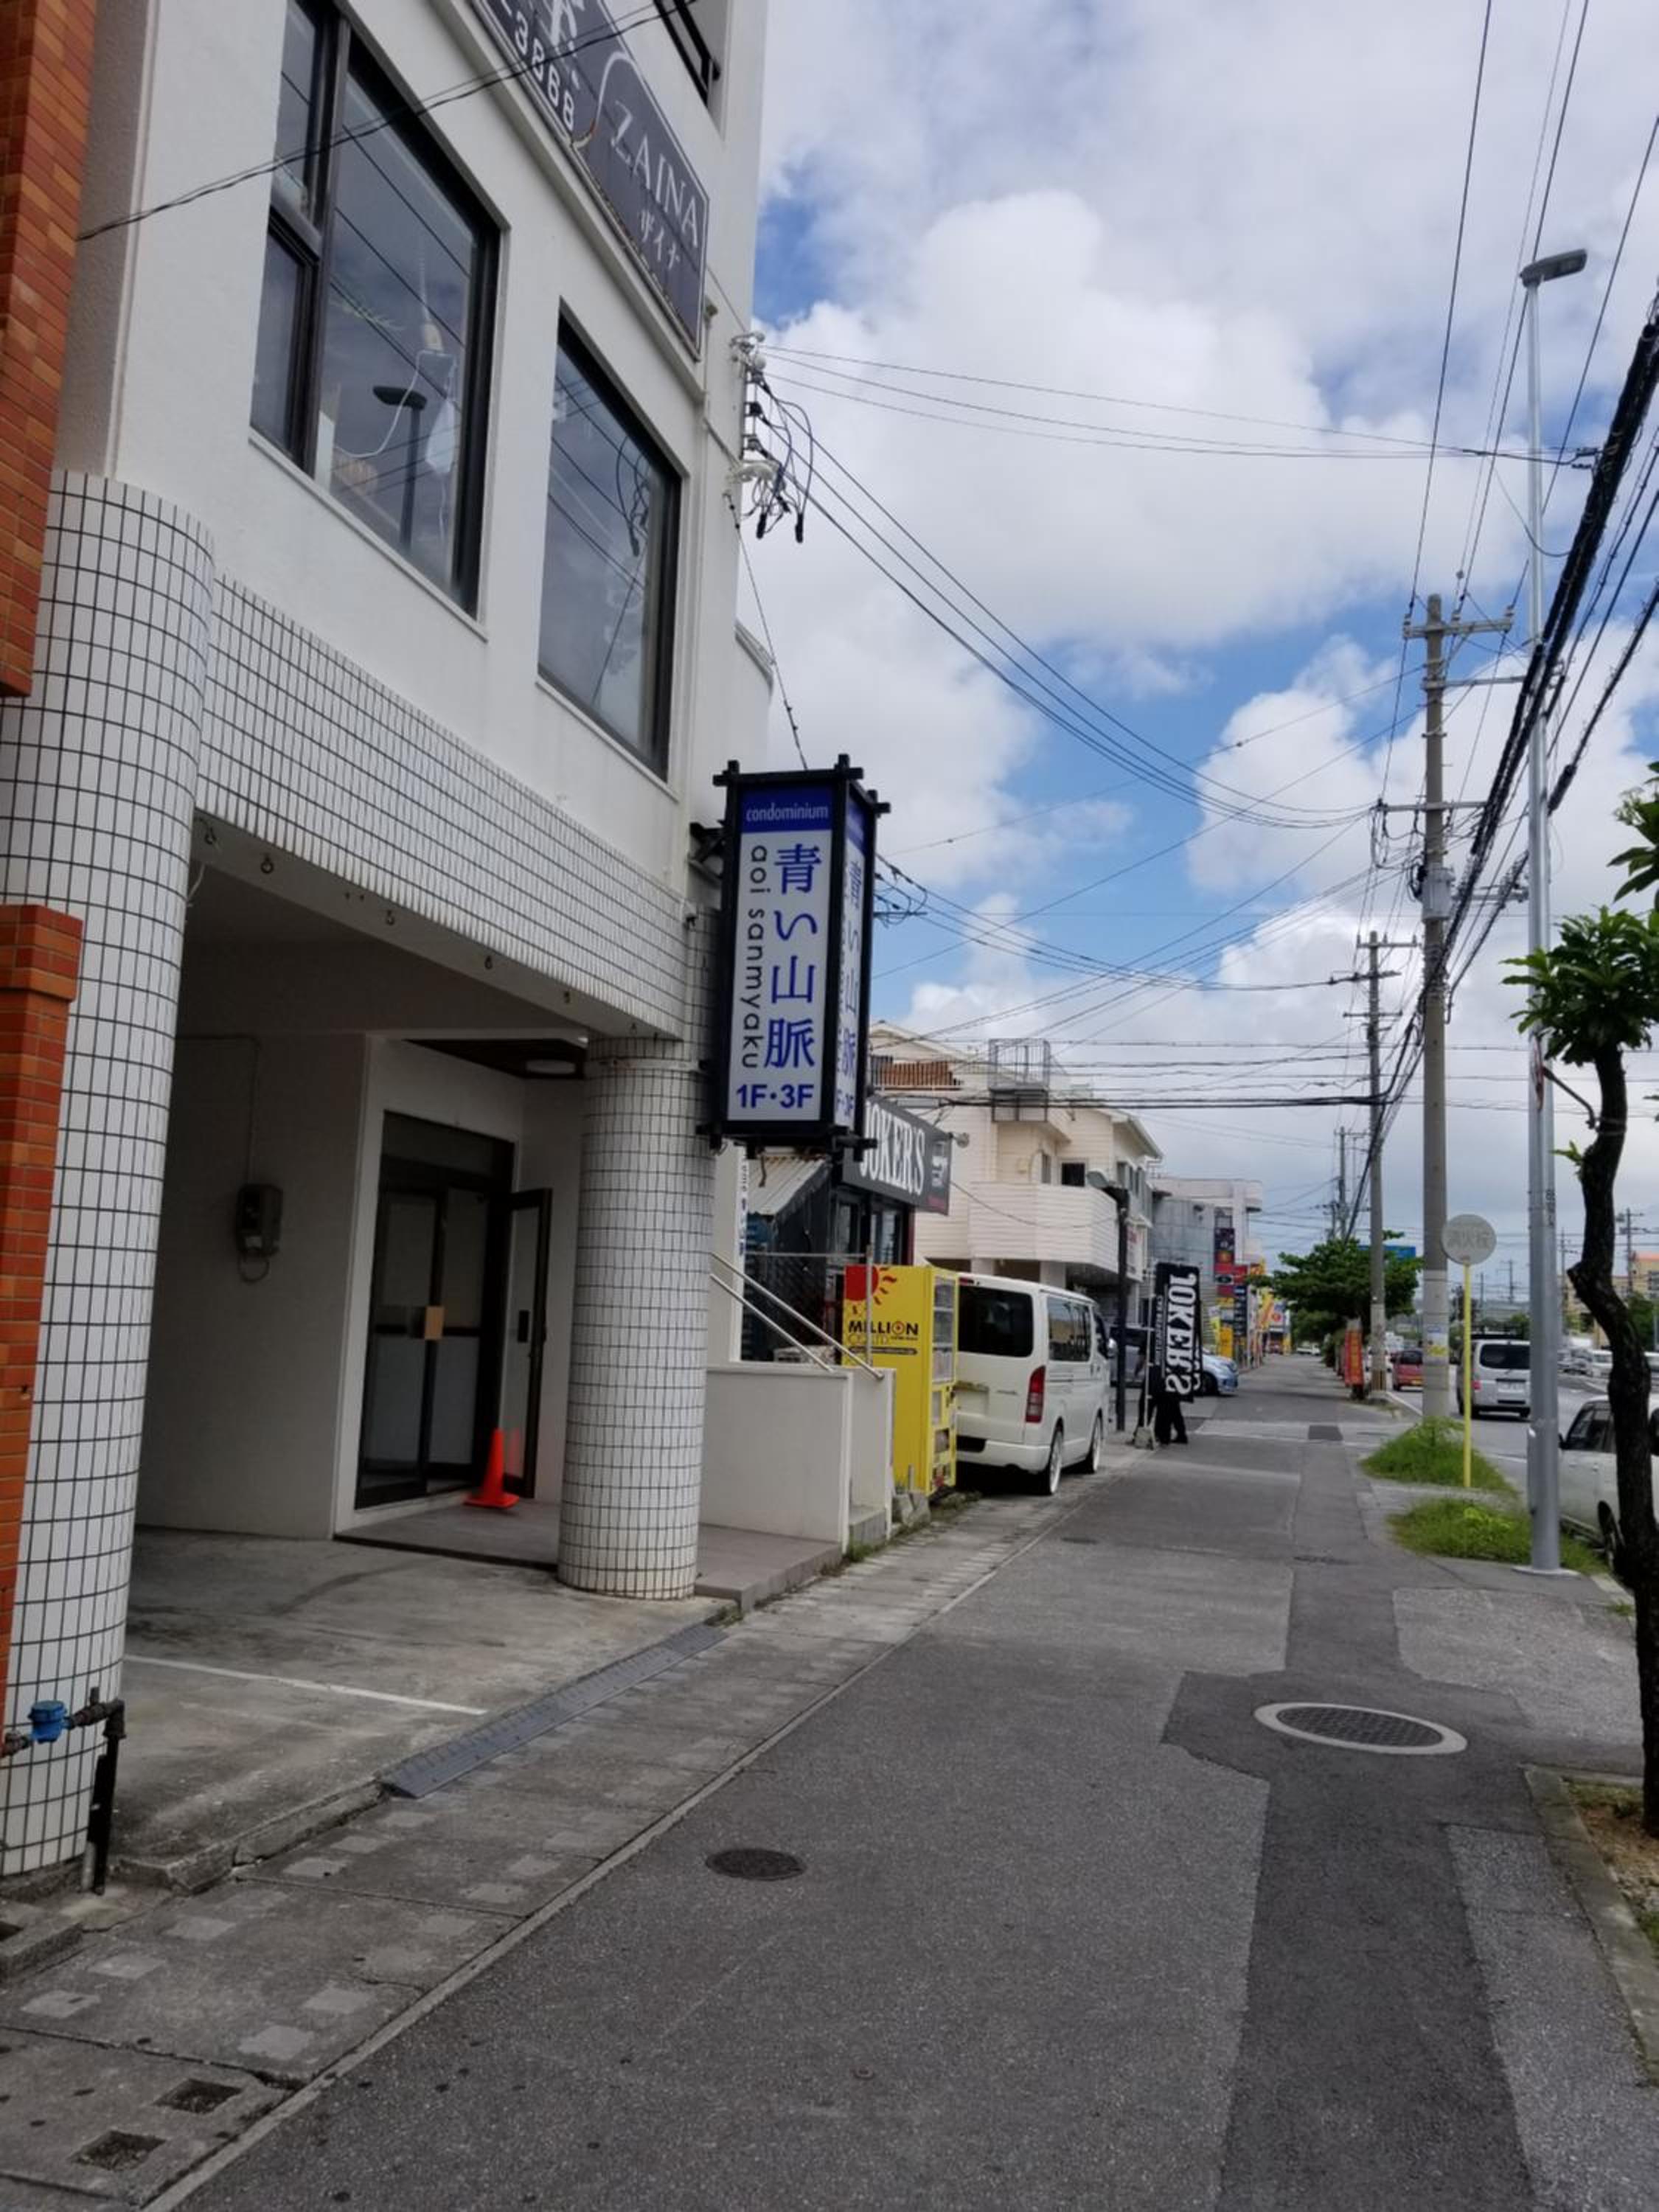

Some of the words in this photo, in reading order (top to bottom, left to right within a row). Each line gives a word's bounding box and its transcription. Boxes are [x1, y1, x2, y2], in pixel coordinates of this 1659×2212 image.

[611, 99, 698, 248] ZAINA
[745, 802, 829, 821] condominium
[750, 845, 771, 894] aoi
[740, 908, 765, 1068] sanmyaku
[763, 844, 822, 1068] 青い山脈
[849, 1321, 919, 1335] MILLION
